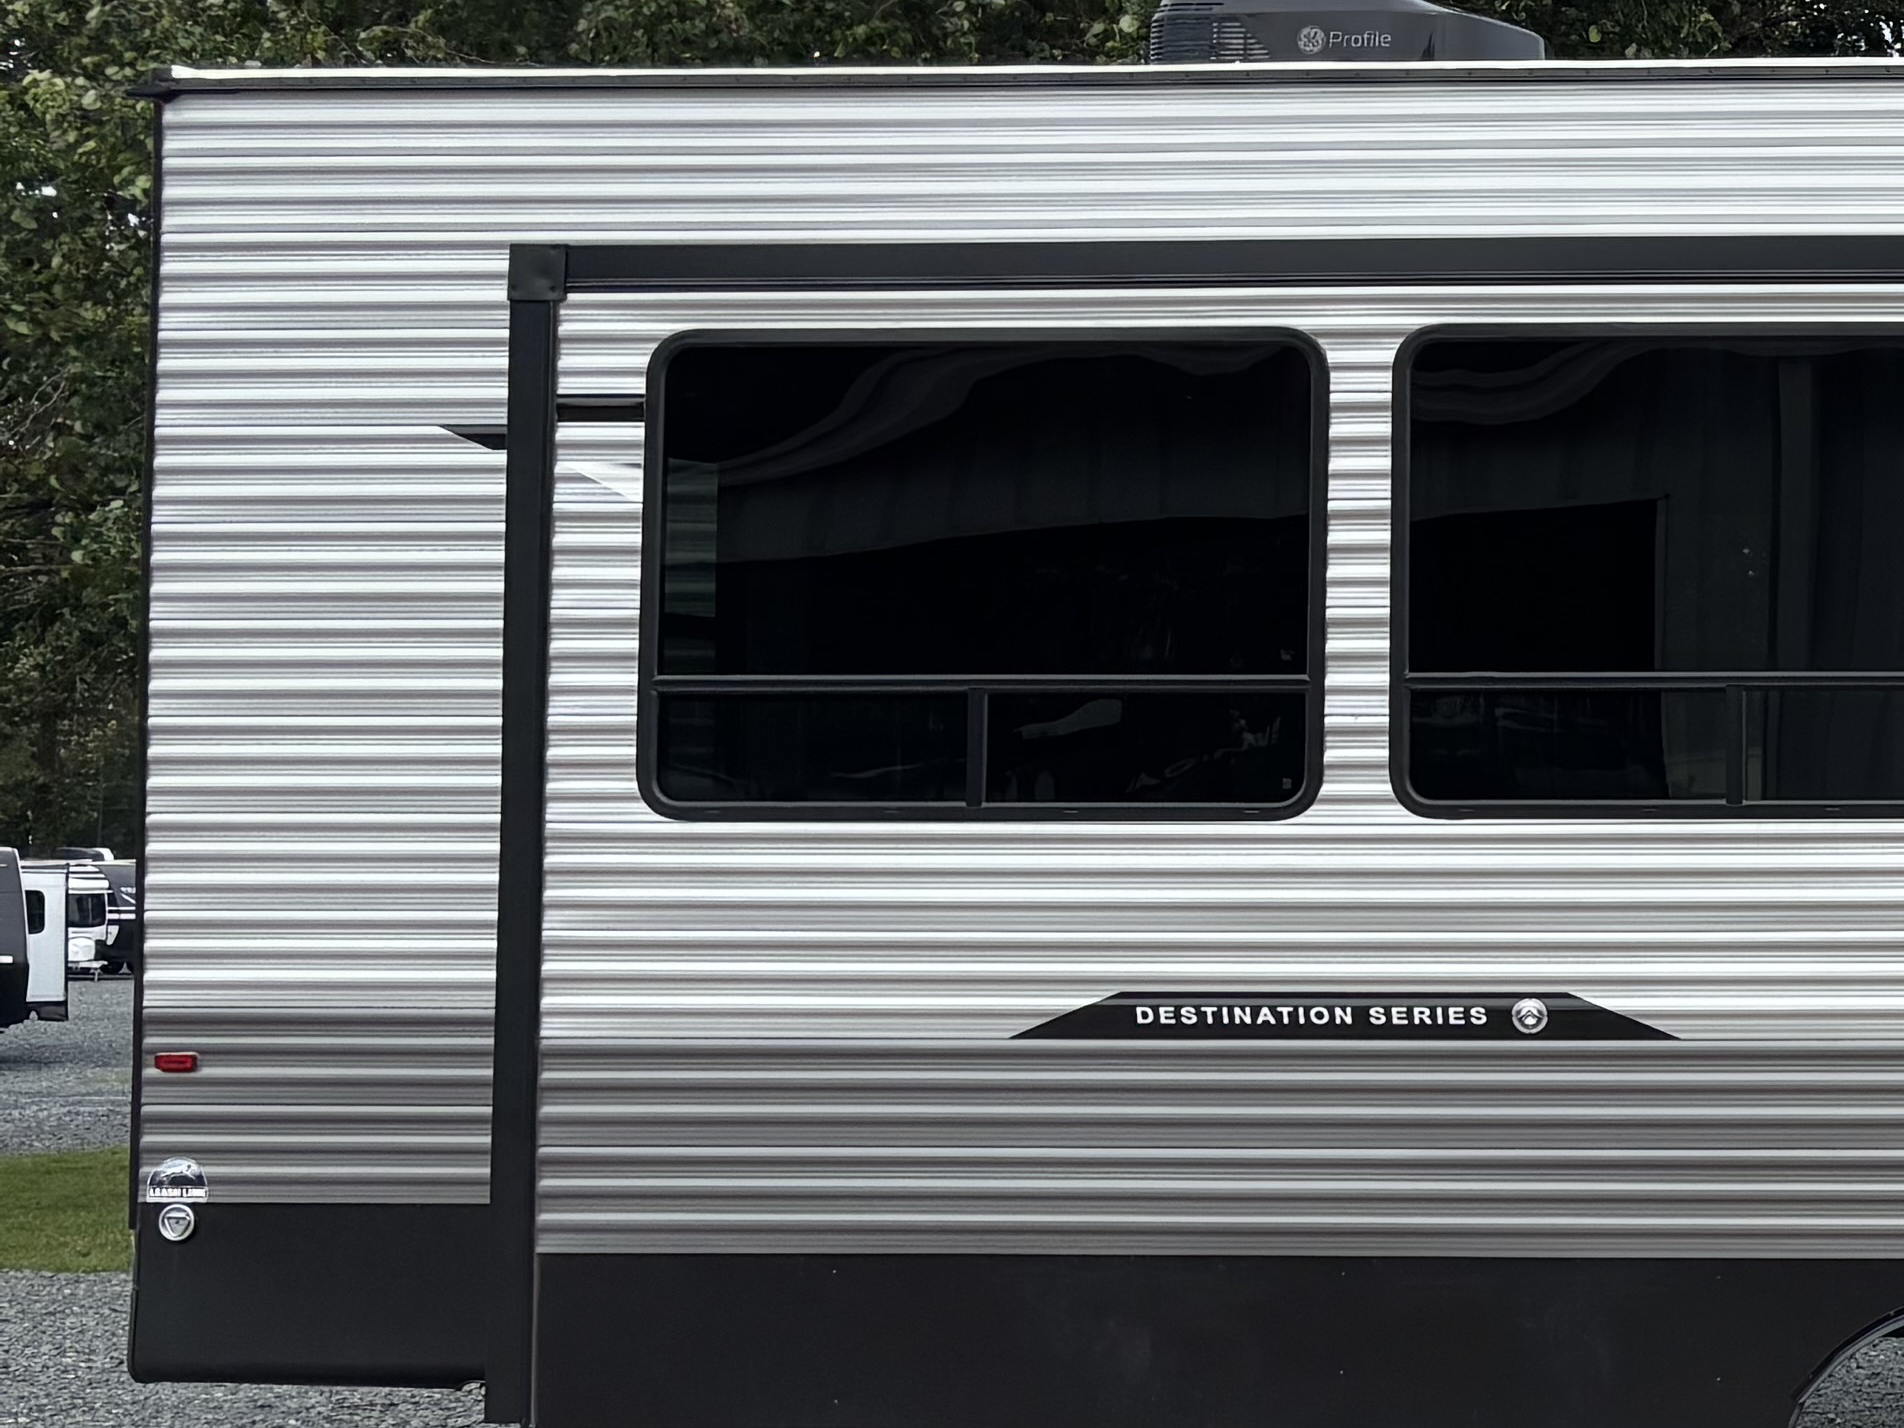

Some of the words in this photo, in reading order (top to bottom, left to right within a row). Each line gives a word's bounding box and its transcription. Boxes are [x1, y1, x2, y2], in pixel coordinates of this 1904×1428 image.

[1329, 31, 1392, 48] Profile
[1136, 1005, 1353, 1026] DESTINATION
[1368, 1005, 1489, 1026] SERIES
